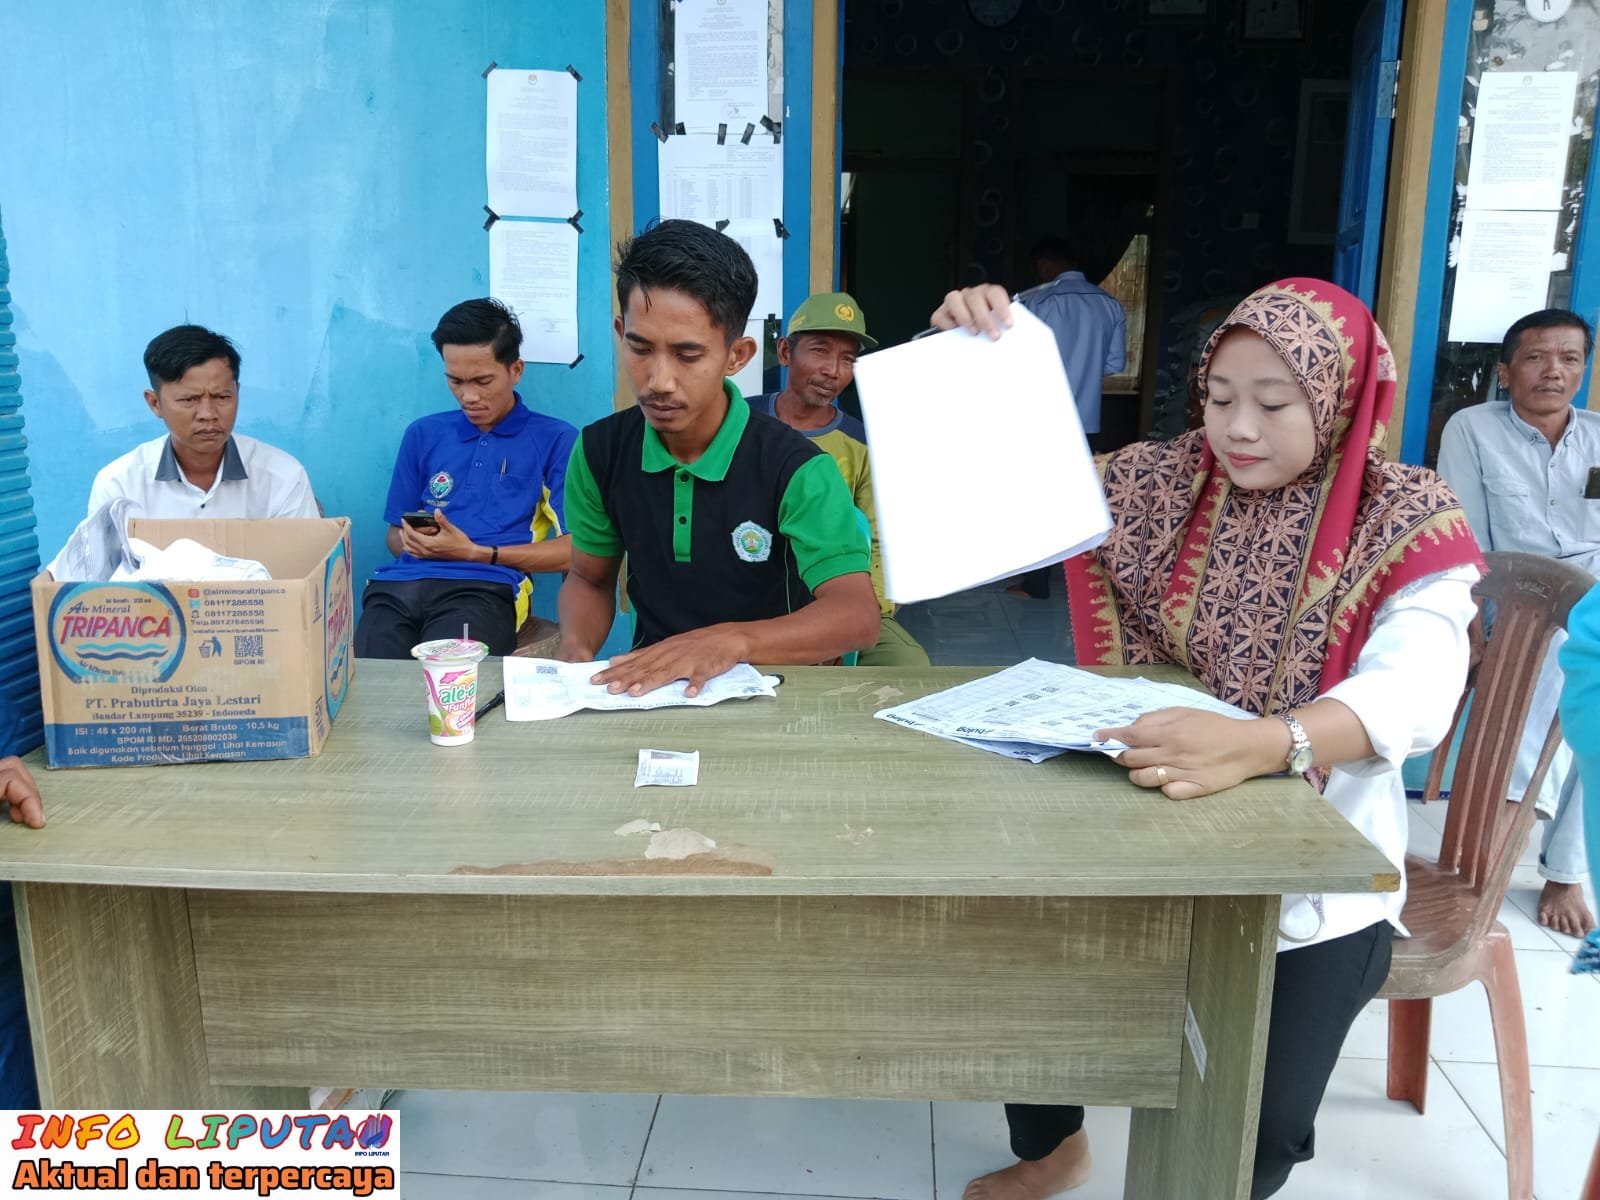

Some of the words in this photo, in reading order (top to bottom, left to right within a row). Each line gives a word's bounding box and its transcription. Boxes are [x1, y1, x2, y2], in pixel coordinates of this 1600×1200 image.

[67, 601, 89, 615] Air
[92, 605, 131, 614] Mineral
[60, 615, 171, 645] TRIPANCA
[131, 686, 183, 696] Diproduksi
[86, 698, 107, 709] PT.
[111, 697, 179, 708] Prabutirta
[182, 696, 212, 708] Jaya
[217, 694, 261, 705] Lestari
[129, 711, 174, 720] Lampung
[212, 708, 256, 717] Indonesia
[96, 727, 109, 735] 48
[119, 726, 136, 734] 200
[139, 725, 152, 734] ml
[182, 724, 208, 732] Berat
[210, 723, 238, 731] Bruto
[267, 721, 280, 731] kg
[117, 736, 145, 745] BPOM
[147, 736, 156, 744] RI
[67, 747, 88, 756] Baik
[90, 746, 139, 756] digunakan
[141, 744, 179, 753] sebelum
[181, 743, 216, 752] tanggal
[223, 741, 244, 749] Lihat
[245, 740, 287, 748] Kemasan
[111, 755, 135, 763] Kode
[205, 750, 247, 759] Kemasan
